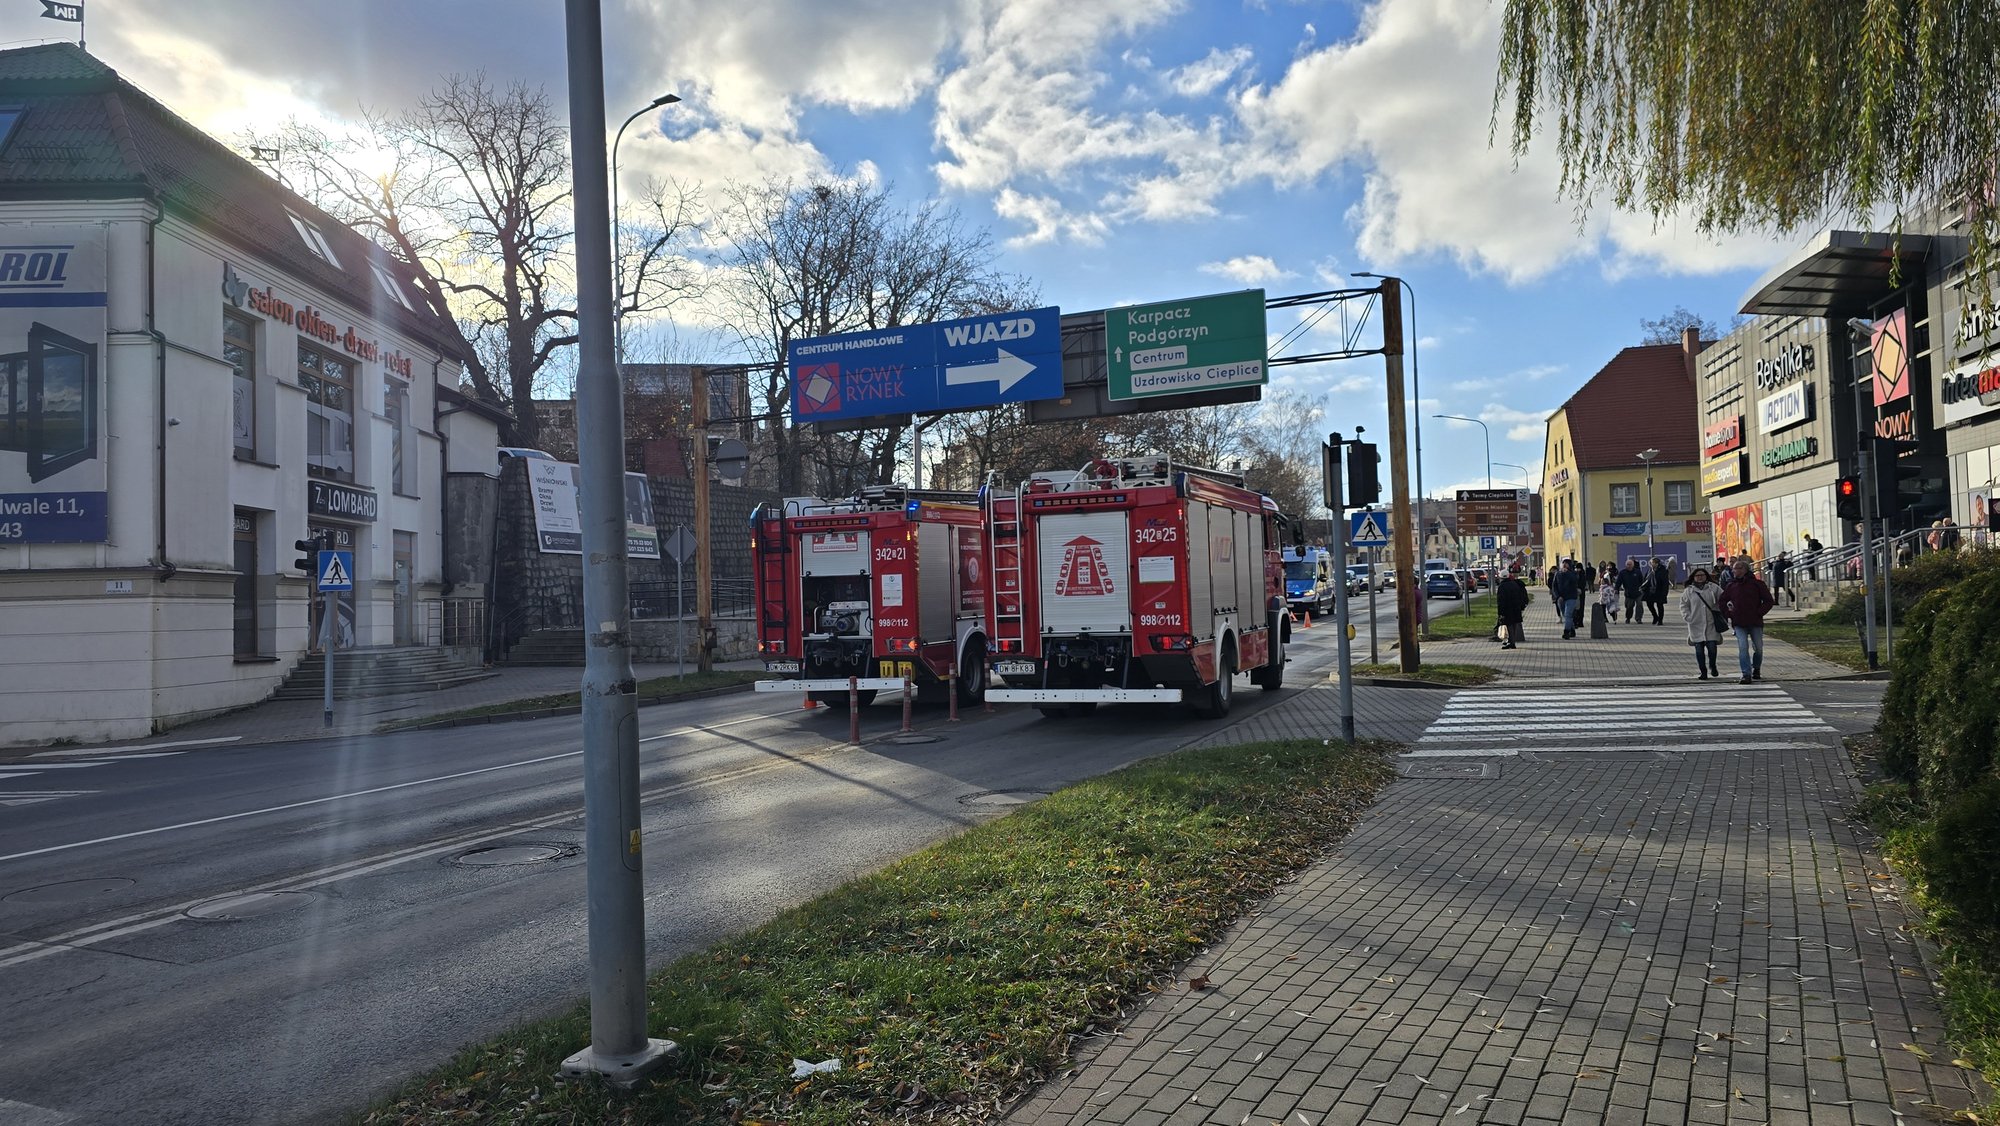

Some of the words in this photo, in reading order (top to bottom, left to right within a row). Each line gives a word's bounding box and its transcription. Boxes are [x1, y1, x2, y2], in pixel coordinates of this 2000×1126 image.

[248, 286, 294, 326] salon
[296, 305, 336, 344] okien
[343, 326, 378, 363] drzwi
[1127, 307, 1192, 326] Karpacz
[943, 318, 1036, 347] WJAZD
[1128, 325, 1209, 345] Podgórzyn
[796, 342, 844, 356] CENTRUM
[844, 335, 904, 351] HANDLOWE
[1133, 351, 1186, 365] Centrum
[1756, 344, 1804, 391] Bershka
[845, 363, 905, 386] NOWY
[1133, 372, 1201, 388] Uzdrowisko
[1206, 364, 1260, 380] Cieplice
[845, 380, 906, 402] RYNEK
[1767, 389, 1800, 426] ACTION
[1874, 409, 1911, 439] NOWY
[1761, 436, 1809, 468] DEICHMANN
[56, 498, 85, 517] 11,
[328, 488, 377, 517] LOMBARD
[878, 618, 891, 627] 998
[896, 618, 909, 627] 112
[1140, 614, 1157, 626] 998
[1165, 614, 1181, 626] 112
[1000, 665, 1009, 673] DW
